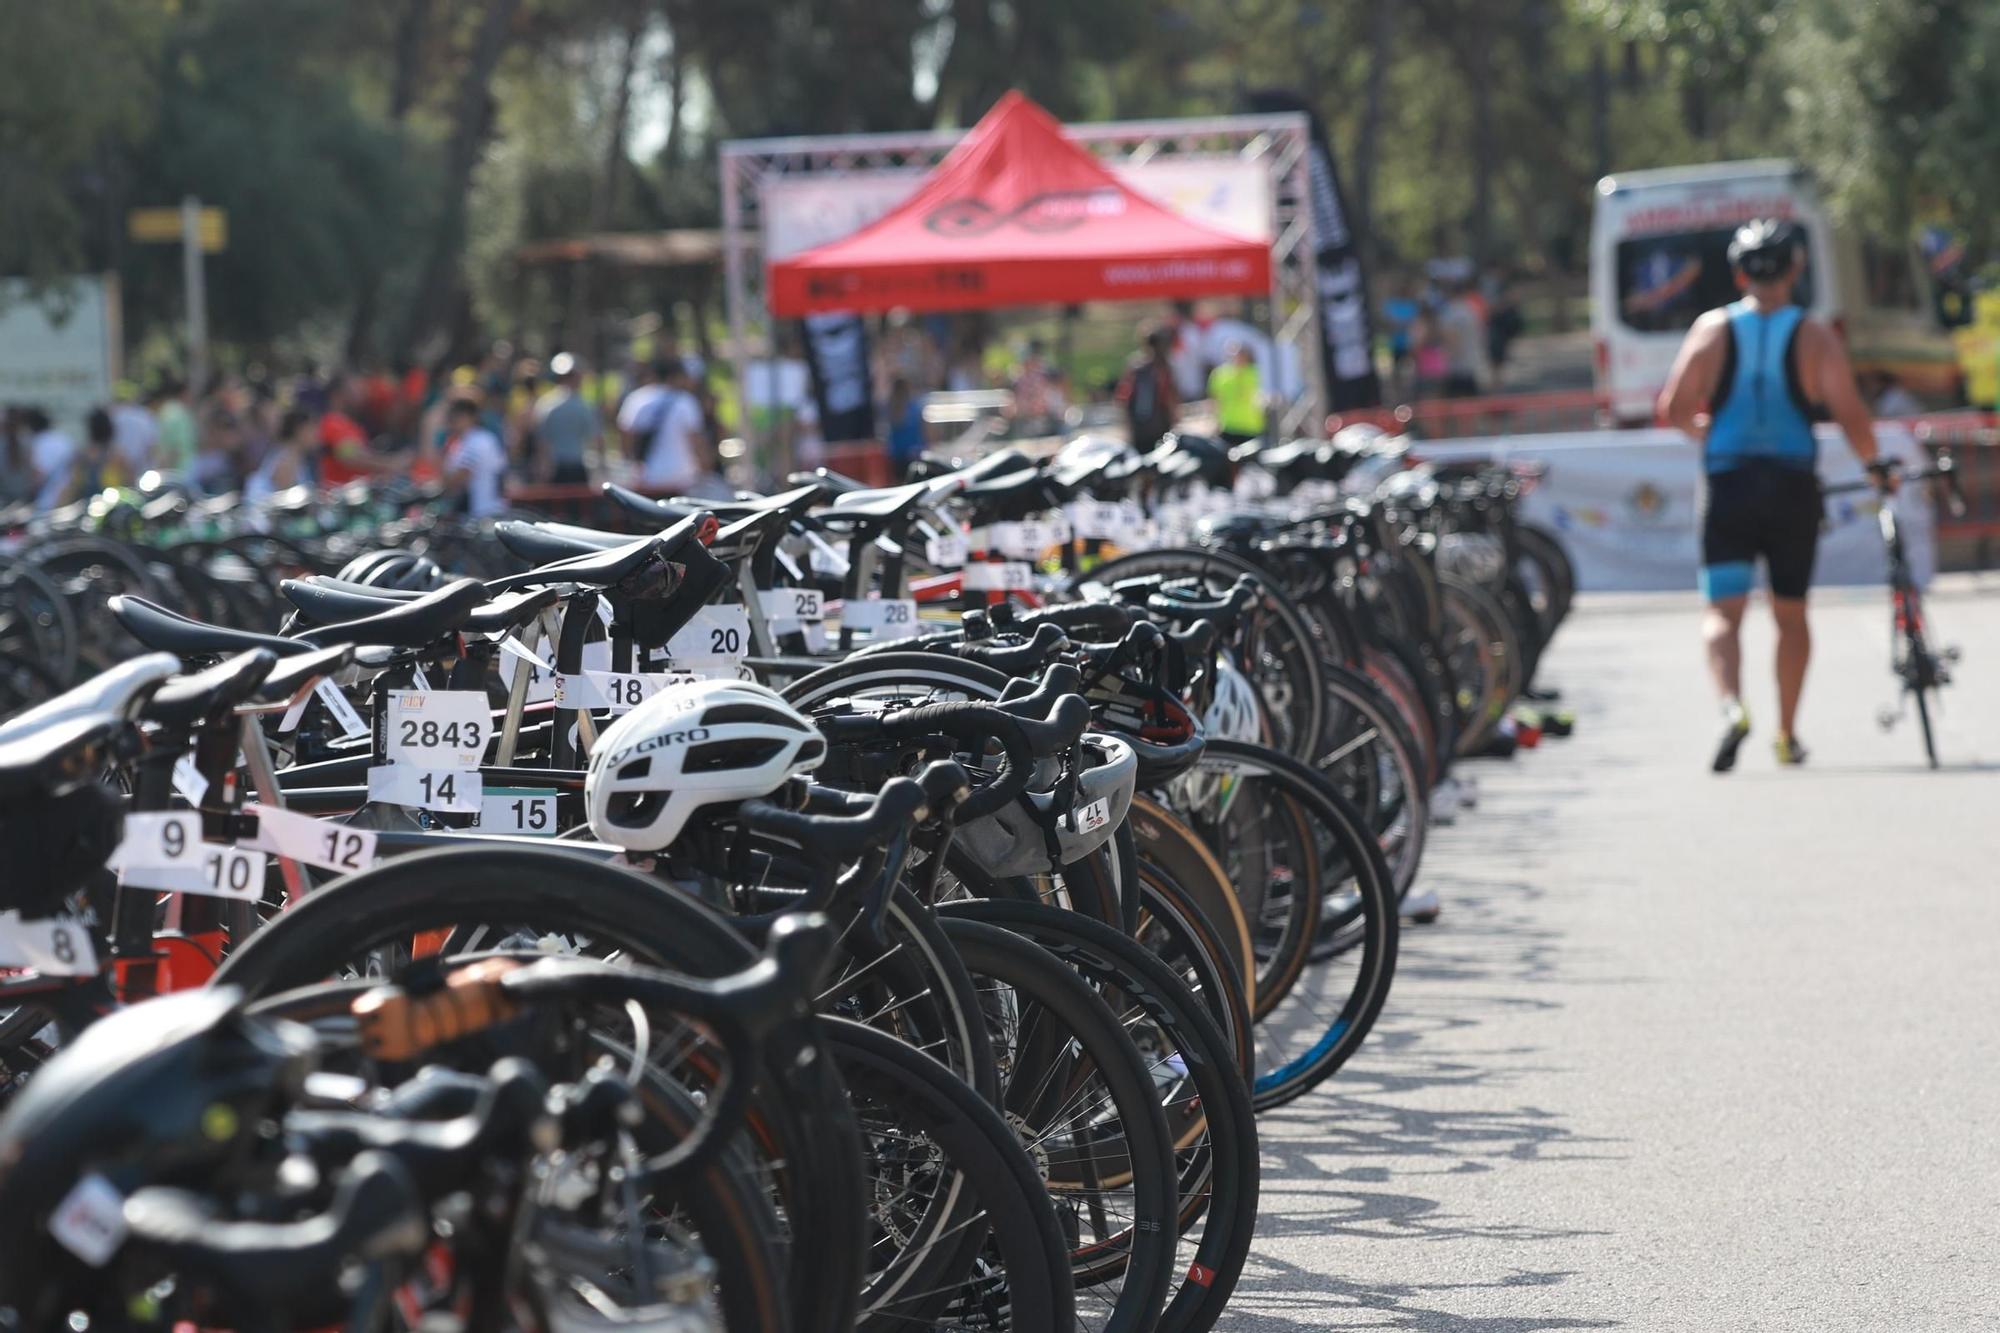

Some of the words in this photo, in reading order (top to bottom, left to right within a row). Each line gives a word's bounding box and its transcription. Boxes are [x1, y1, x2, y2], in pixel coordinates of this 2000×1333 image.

[796, 594, 818, 616] 25
[885, 603, 909, 624] 28
[710, 628, 740, 654] 20
[610, 678, 643, 706] 18
[400, 719, 481, 749] 2843
[636, 727, 710, 753] GIRO
[419, 772, 456, 805] 14
[511, 799, 547, 830] 15
[1086, 803, 1102, 821] 17
[162, 819, 185, 858] 9
[325, 829, 363, 870] 12
[207, 853, 250, 892] 10
[52, 928, 76, 964] 8
[1139, 1220, 1161, 1232] 35
